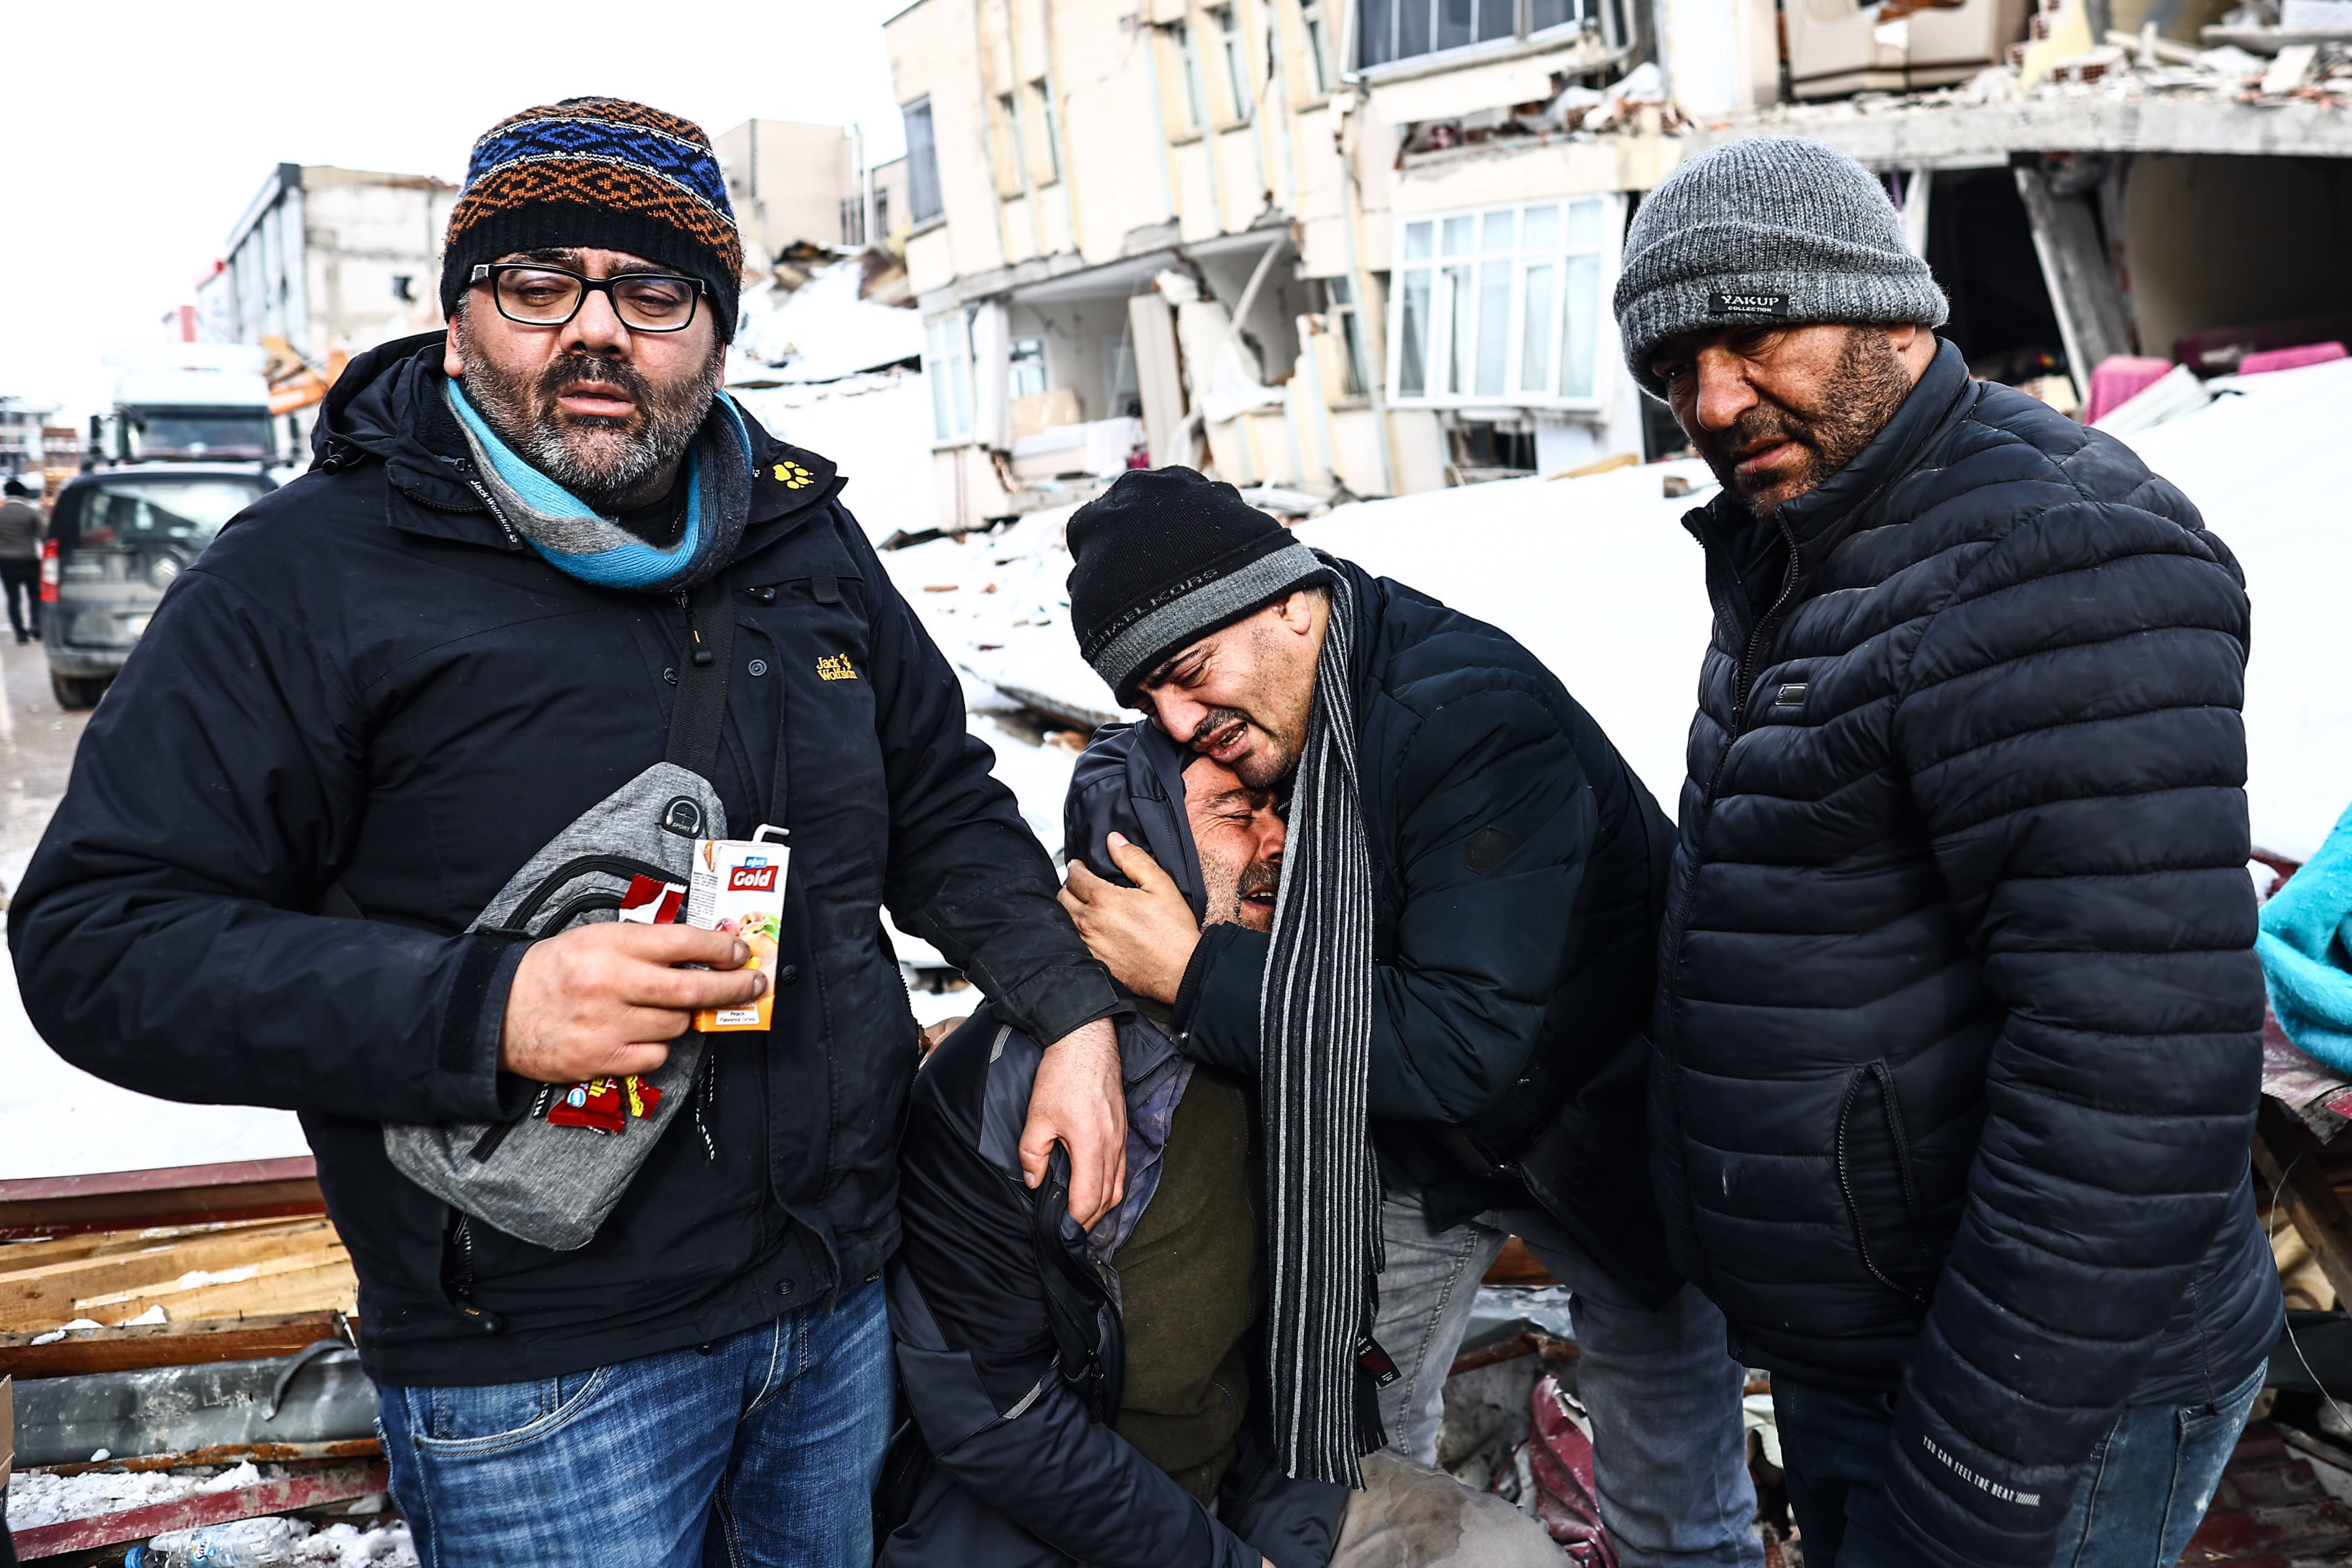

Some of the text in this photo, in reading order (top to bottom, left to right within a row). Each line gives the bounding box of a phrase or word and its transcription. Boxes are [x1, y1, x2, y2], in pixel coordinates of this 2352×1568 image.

[1720, 295, 1780, 306] YAKUP
[1150, 569, 1218, 606] KORS
[816, 655, 841, 670] Jack
[817, 666, 858, 681] Wolfskin
[672, 822, 691, 832] SPORT
[733, 869, 773, 887] Gold
[1923, 1435, 1936, 1454] YOU
[1938, 1449, 1953, 1469] CAN
[1954, 1462, 1972, 1483] FEEL
[1973, 1473, 1991, 1492] THE
